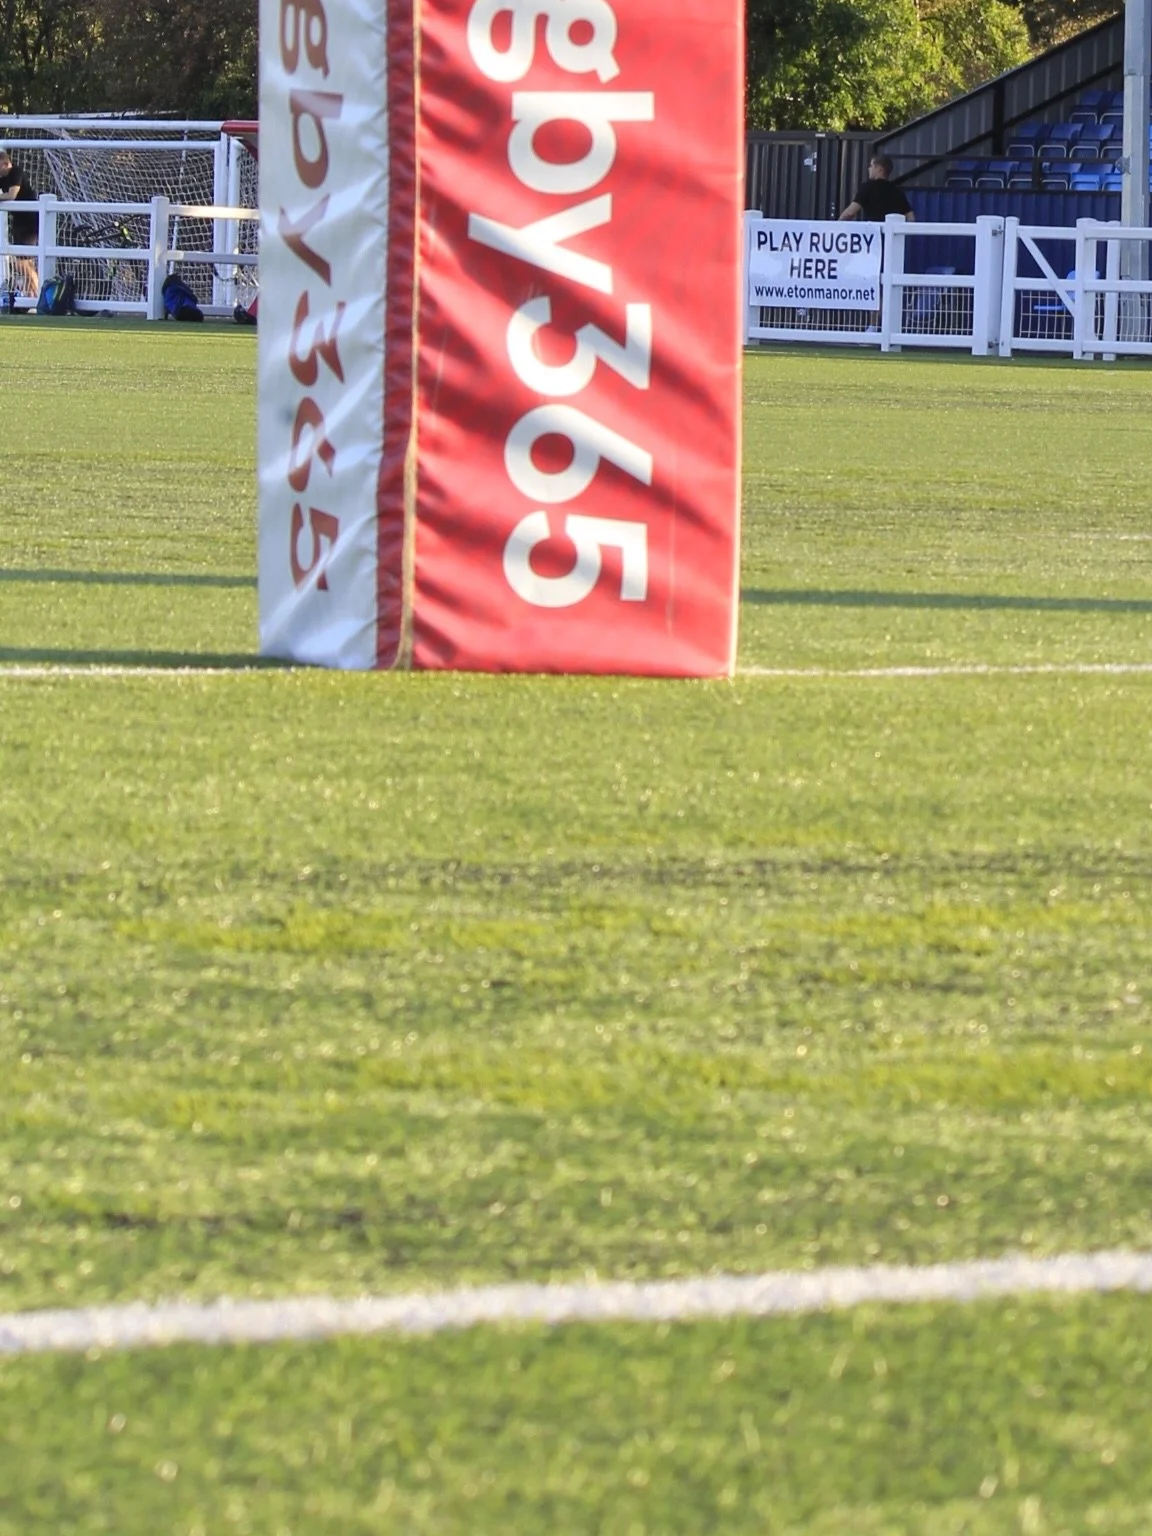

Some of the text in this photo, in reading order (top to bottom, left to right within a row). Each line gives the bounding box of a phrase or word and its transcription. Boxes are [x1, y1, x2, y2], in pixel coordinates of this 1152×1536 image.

[757, 231, 874, 253] PLAY RUGBY
[790, 258, 838, 279] HERE
[755, 284, 875, 301] www.etonmanor.net
